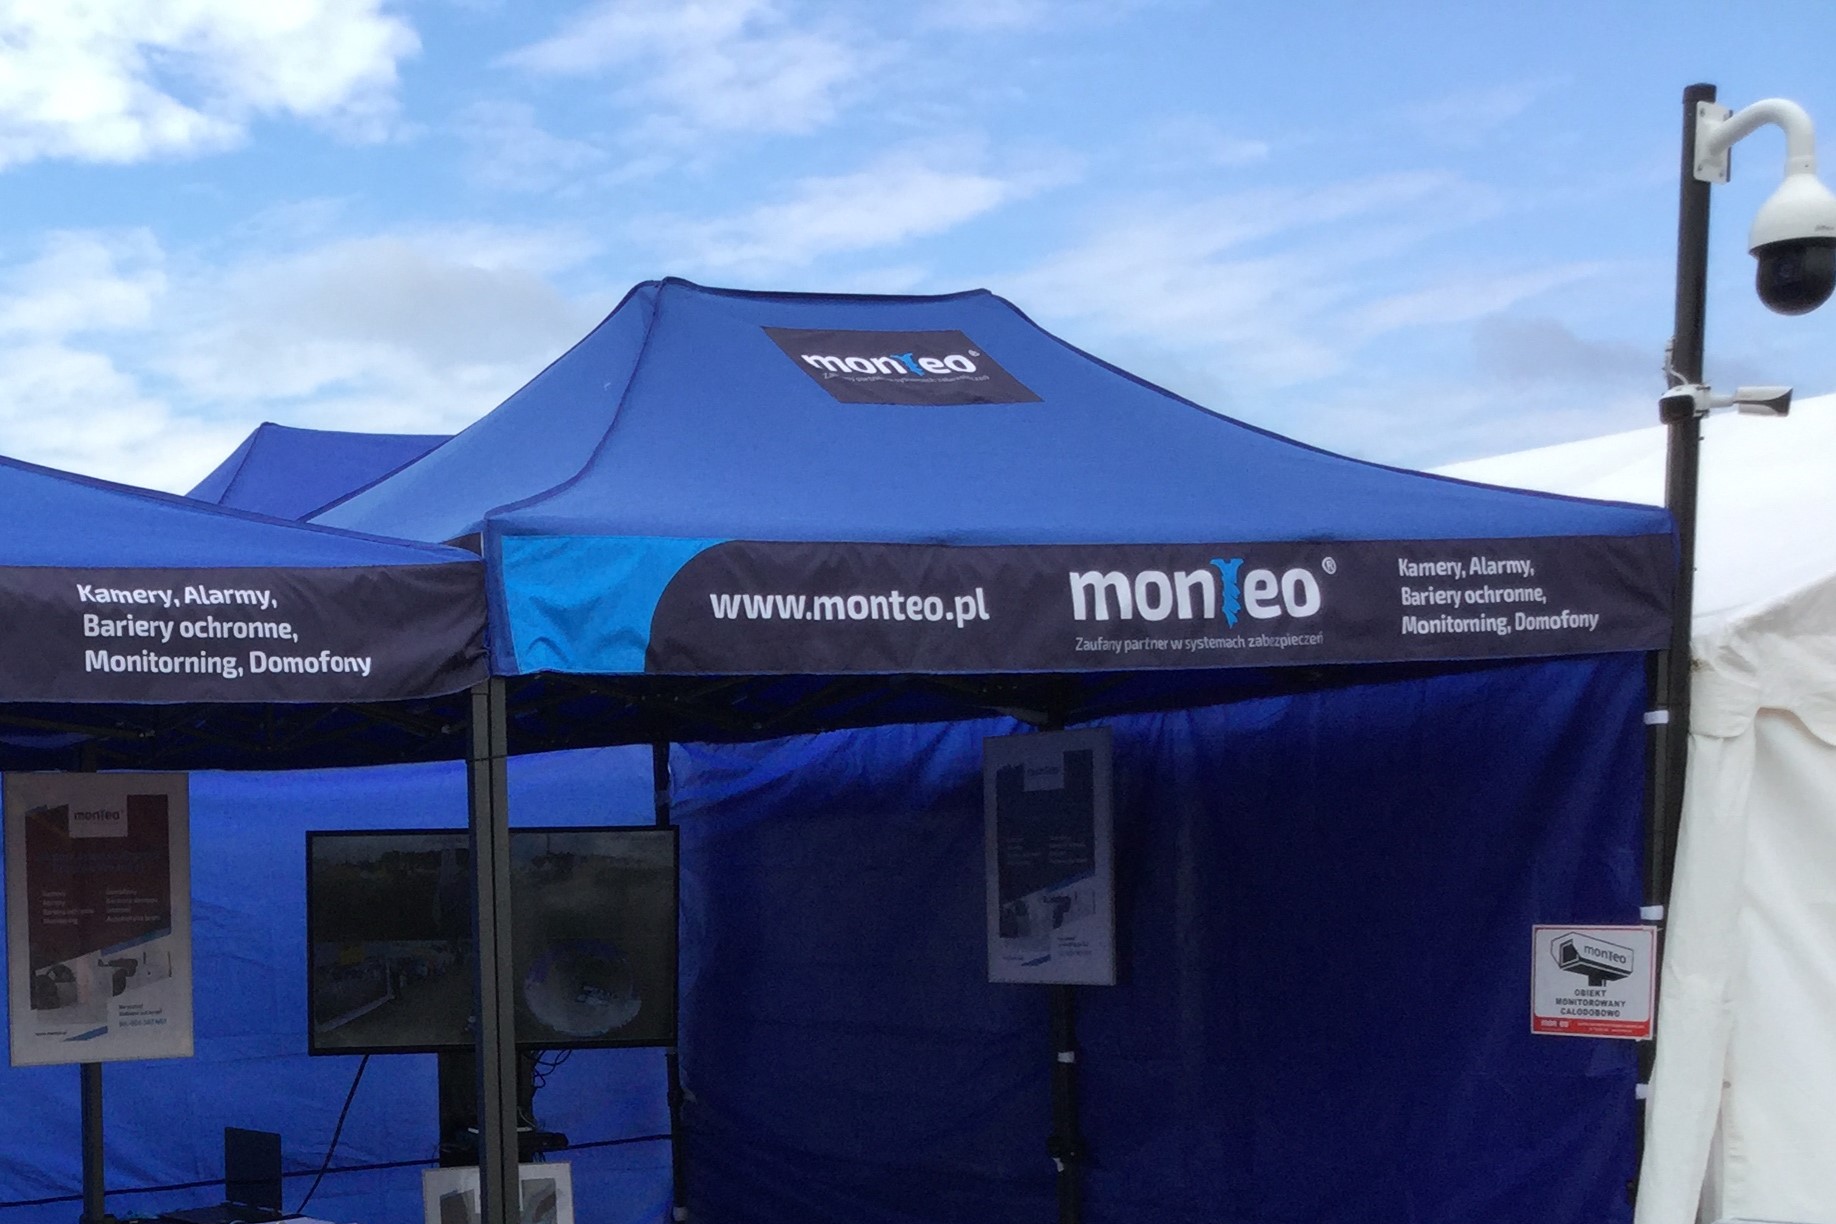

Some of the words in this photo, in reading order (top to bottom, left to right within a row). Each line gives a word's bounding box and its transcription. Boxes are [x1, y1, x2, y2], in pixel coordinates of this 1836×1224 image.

[1398, 557, 1467, 580] Kamery,
[1469, 556, 1535, 578] Alarmy,
[76, 583, 181, 608] Kamery,
[184, 585, 278, 609] Alarmy,
[709, 587, 991, 628] www.monteo.pl
[1401, 587, 1462, 608] Bariery
[1464, 585, 1547, 605] ochronne,
[83, 613, 174, 643] Bariery
[179, 616, 299, 643] ochronne,
[1401, 614, 1512, 636] Monitorning,
[1515, 609, 1600, 632] Domofony
[1074, 636, 1122, 655] Zaufany
[1123, 635, 1169, 653] partner
[1170, 639, 1183, 651] w
[1184, 634, 1246, 652] systemach
[85, 649, 245, 679] Monitorning,
[249, 650, 372, 677] Domofony
[1555, 997, 1626, 1008] MONITOROWANY
[1574, 988, 1607, 997] OBIEKT
